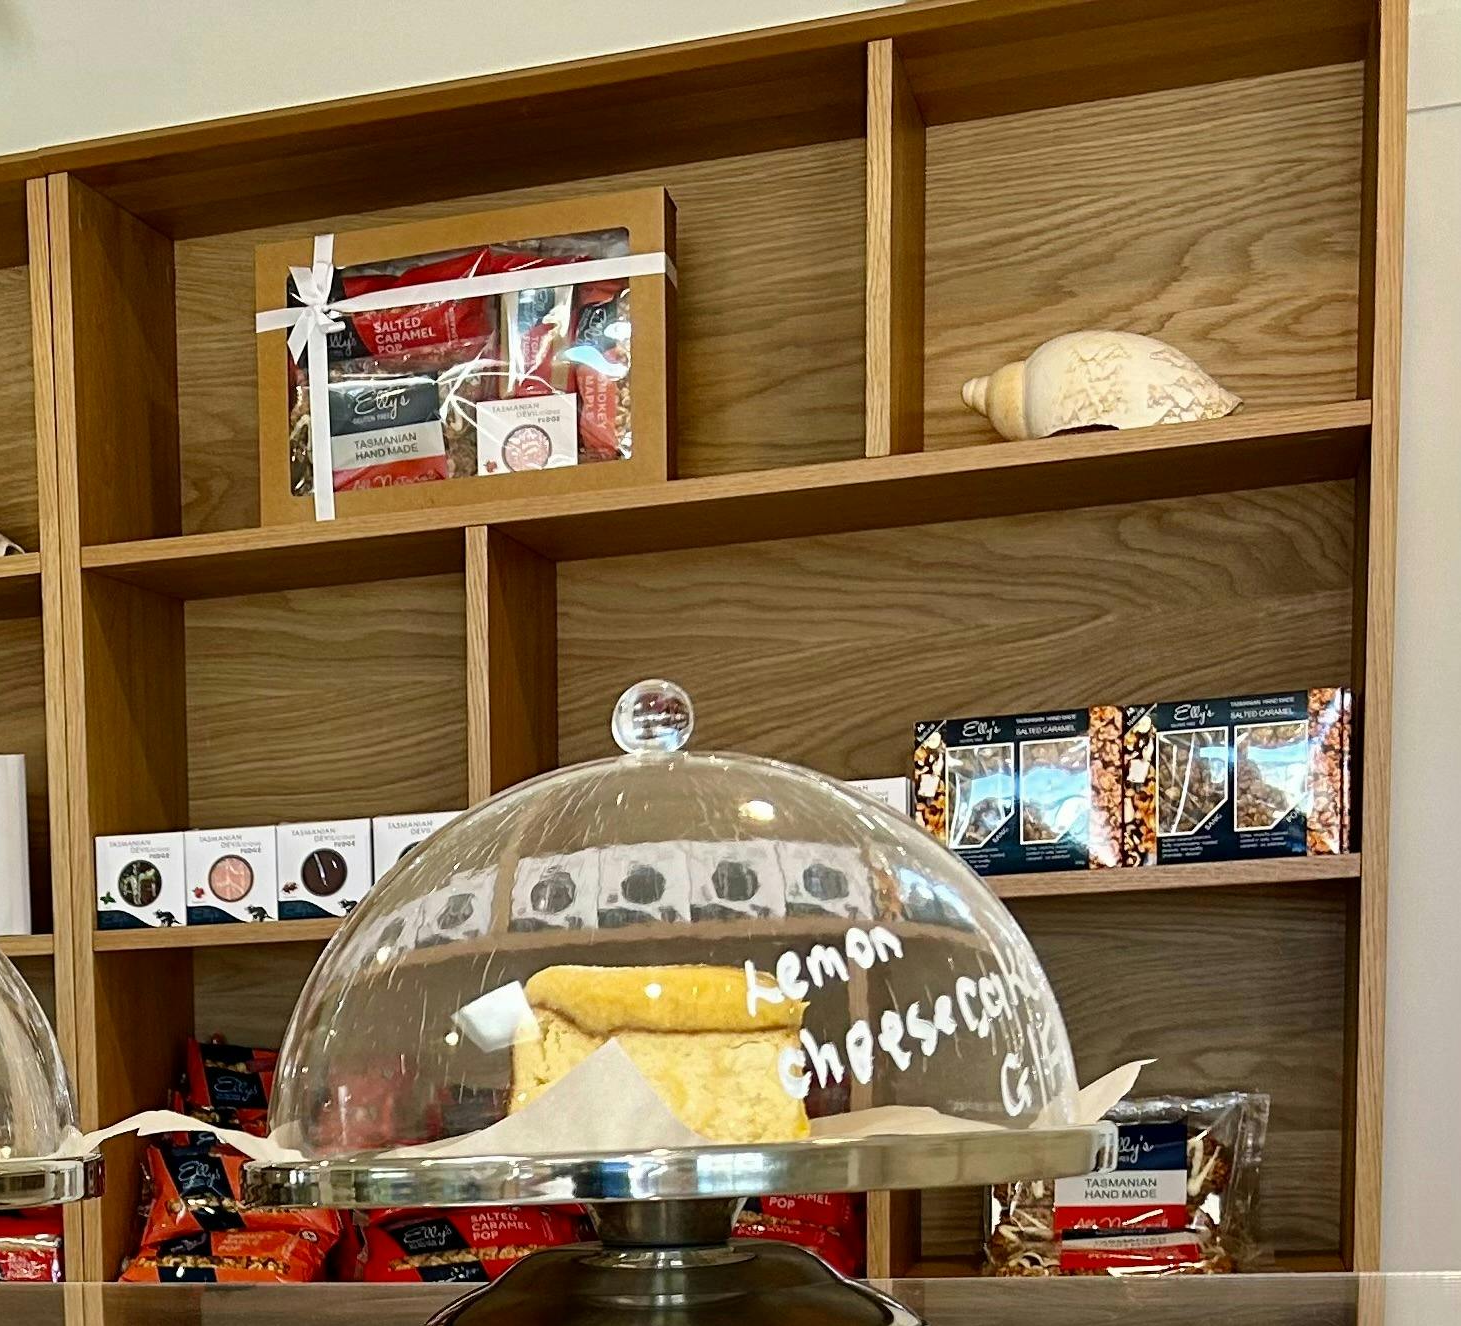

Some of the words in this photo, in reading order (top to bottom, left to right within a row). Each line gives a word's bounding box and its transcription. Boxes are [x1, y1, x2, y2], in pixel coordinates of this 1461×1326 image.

[373, 317, 421, 333] SALTED
[374, 327, 437, 345] CARAMEL
[353, 386, 411, 420] Elly's
[492, 403, 541, 414] TASMANIAN
[355, 432, 417, 450] TASMANIAN
[355, 448, 386, 461] HAND
[387, 443, 419, 456] MADE
[1173, 704, 1215, 725] Elly's
[1230, 709, 1257, 719] SALTED
[1258, 706, 1294, 716] CARAMEL
[962, 720, 1002, 741] Elly's
[1015, 727, 1042, 736] SALTED
[1042, 725, 1076, 734] CARAMEL
[388, 820, 434, 830] TASMANIAN
[742, 925, 904, 1017] Lemon
[1084, 1178, 1157, 1188] TASMANIAN
[1084, 1189, 1119, 1199] HAND
[1121, 1188, 1157, 1199] MADE
[768, 1196, 796, 1210] POP
[470, 1212, 518, 1224] SALTED
[471, 1221, 532, 1233] CARAMEL
[472, 1230, 499, 1241] POP
